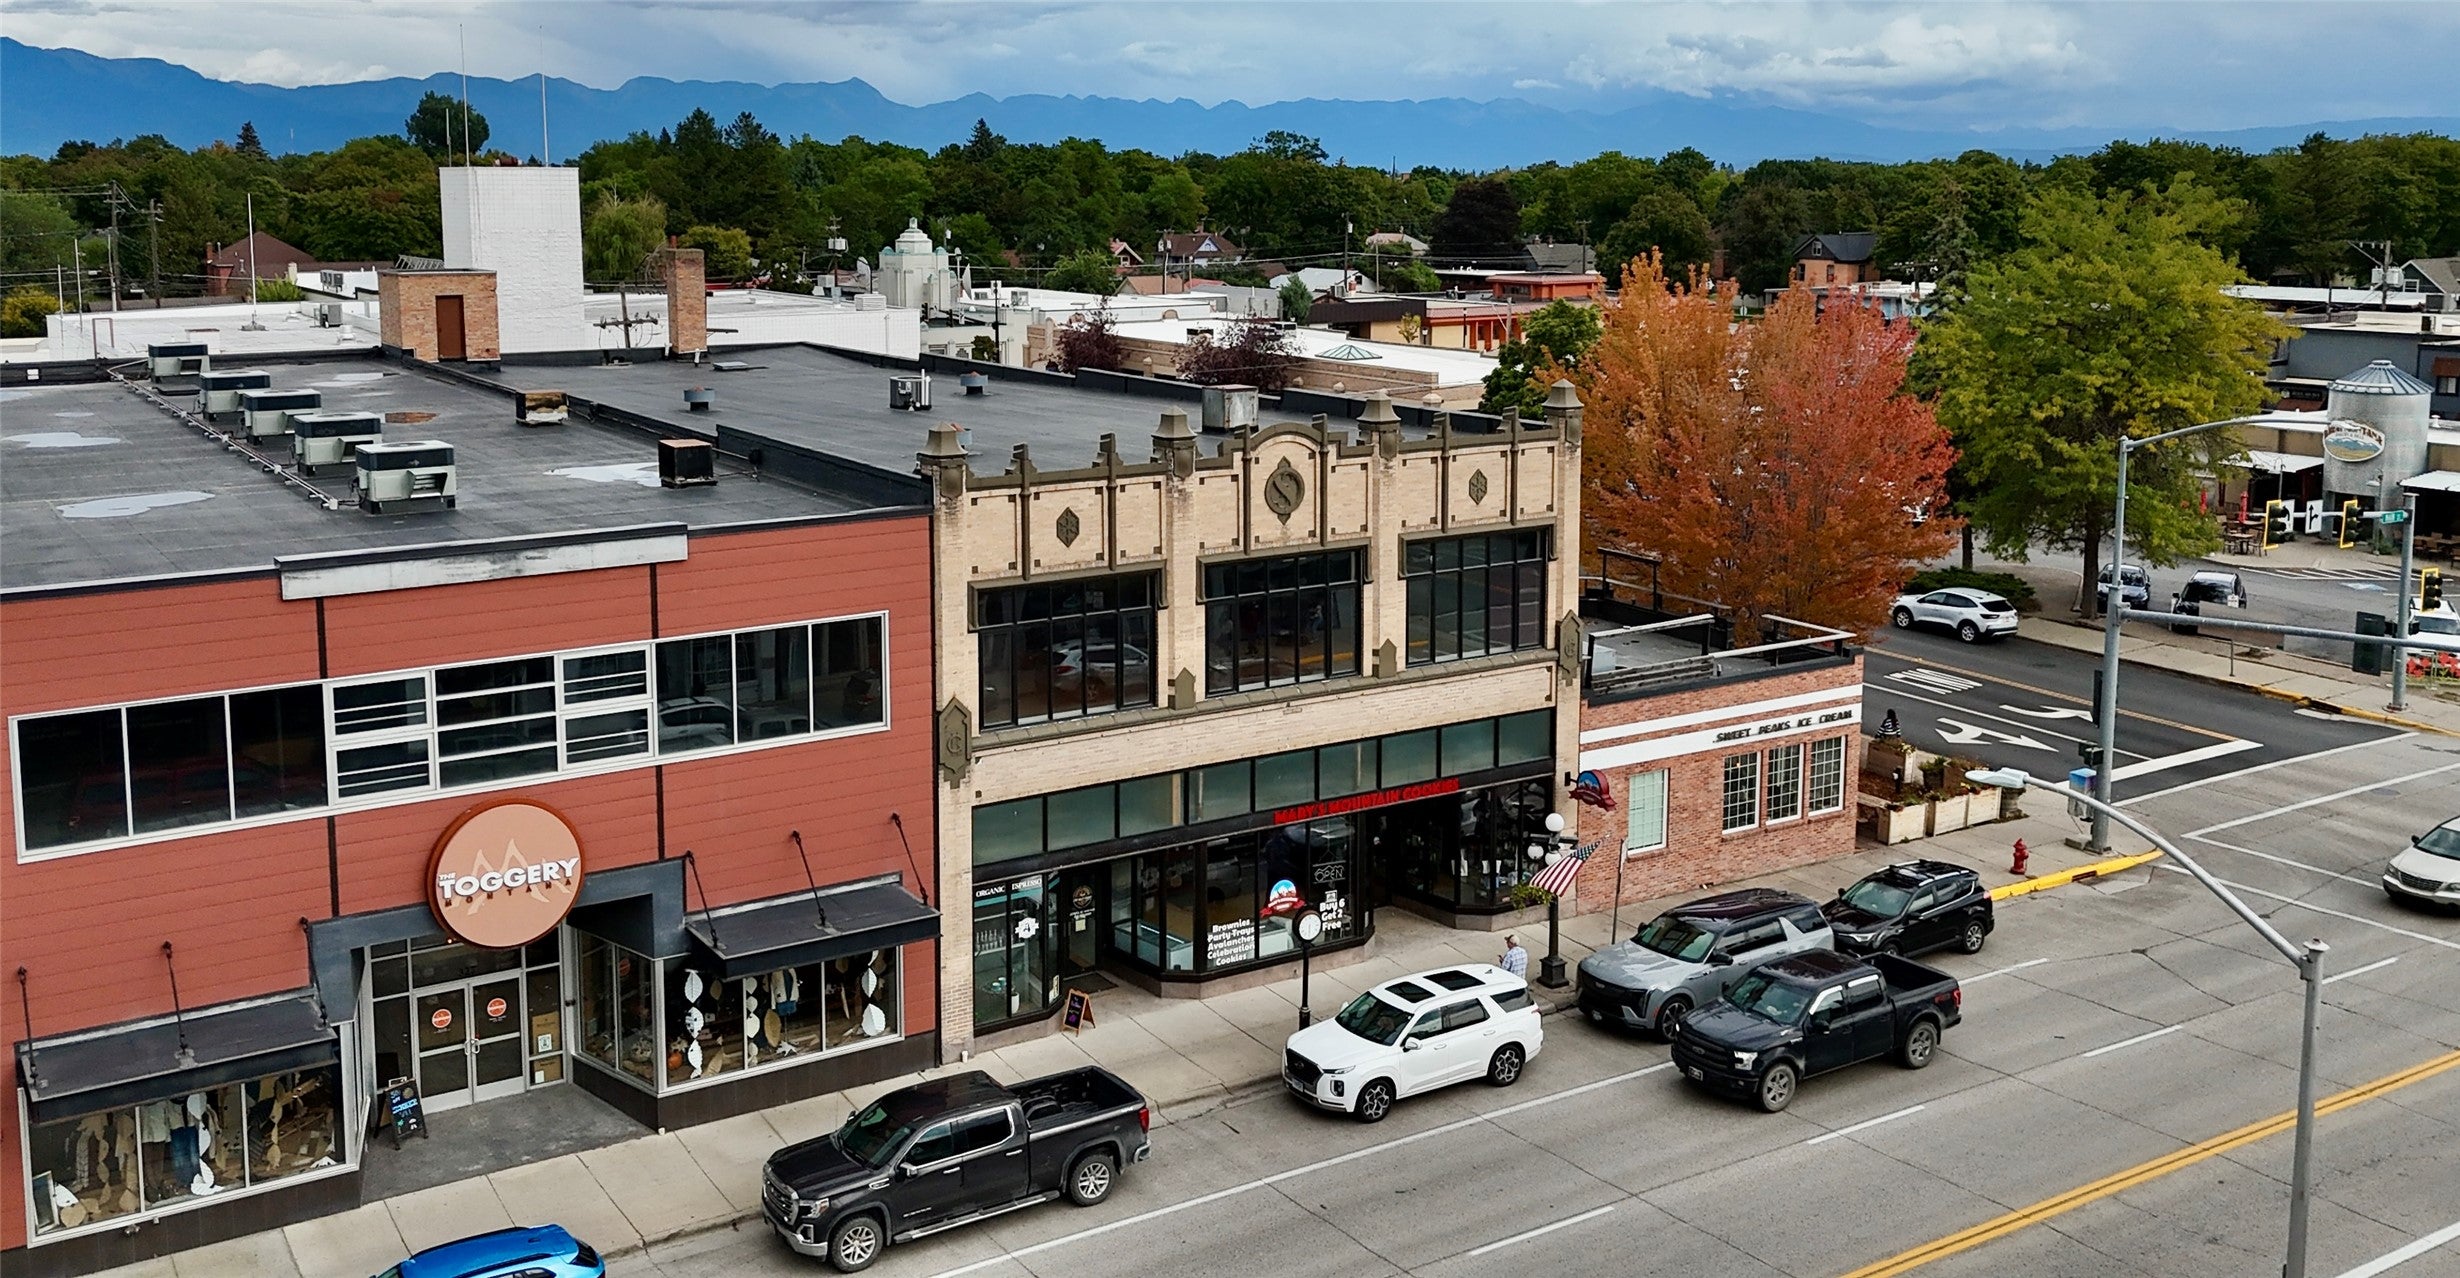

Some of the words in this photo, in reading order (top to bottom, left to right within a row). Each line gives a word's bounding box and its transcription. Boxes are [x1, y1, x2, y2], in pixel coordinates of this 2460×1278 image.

[1716, 728, 1751, 742] SWEET
[1758, 721, 1791, 735] PEAKS
[1797, 717, 1812, 728] ICE
[1818, 710, 1852, 724] CREAM
[1327, 790, 1400, 814] MOUNTAIN
[1402, 778, 1459, 800] COOKIES
[438, 872, 457, 881] THE
[438, 857, 580, 899] TOGGERY
[1314, 868, 1344, 882] OPEN
[444, 878, 572, 907] MONTANA
[976, 886, 1006, 897] ORGANIC
[1320, 902, 1338, 912] Buy
[1339, 898, 1346, 908] 6
[1321, 912, 1337, 921] Get
[1337, 909, 1343, 918] 2
[1212, 919, 1250, 933] Brownies
[1322, 920, 1342, 931] Free
[1207, 935, 1255, 951] Avalanches
[1207, 943, 1255, 959] Celebration
[1216, 953, 1247, 966] Cookies
